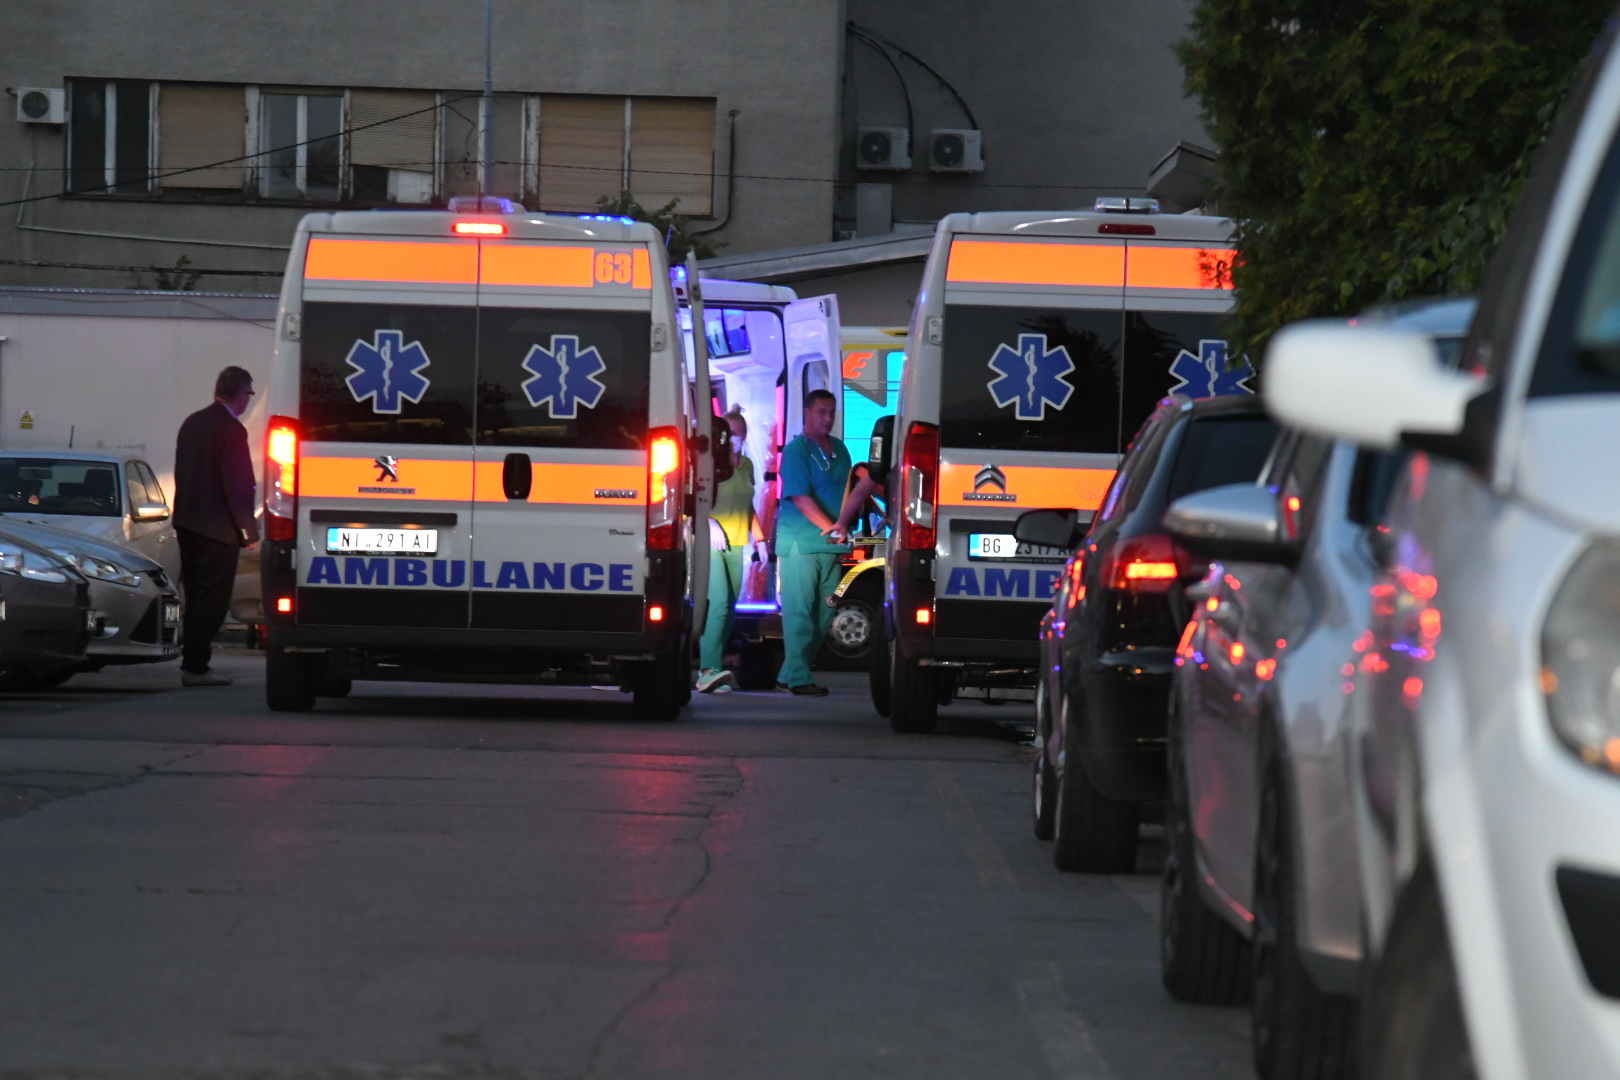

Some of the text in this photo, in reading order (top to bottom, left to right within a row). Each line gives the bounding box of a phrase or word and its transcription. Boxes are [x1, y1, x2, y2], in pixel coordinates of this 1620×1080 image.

[595, 252, 632, 284] 63
[341, 532, 359, 548] NI
[982, 538, 1001, 553] BG
[306, 557, 634, 592] AMBULANCE
